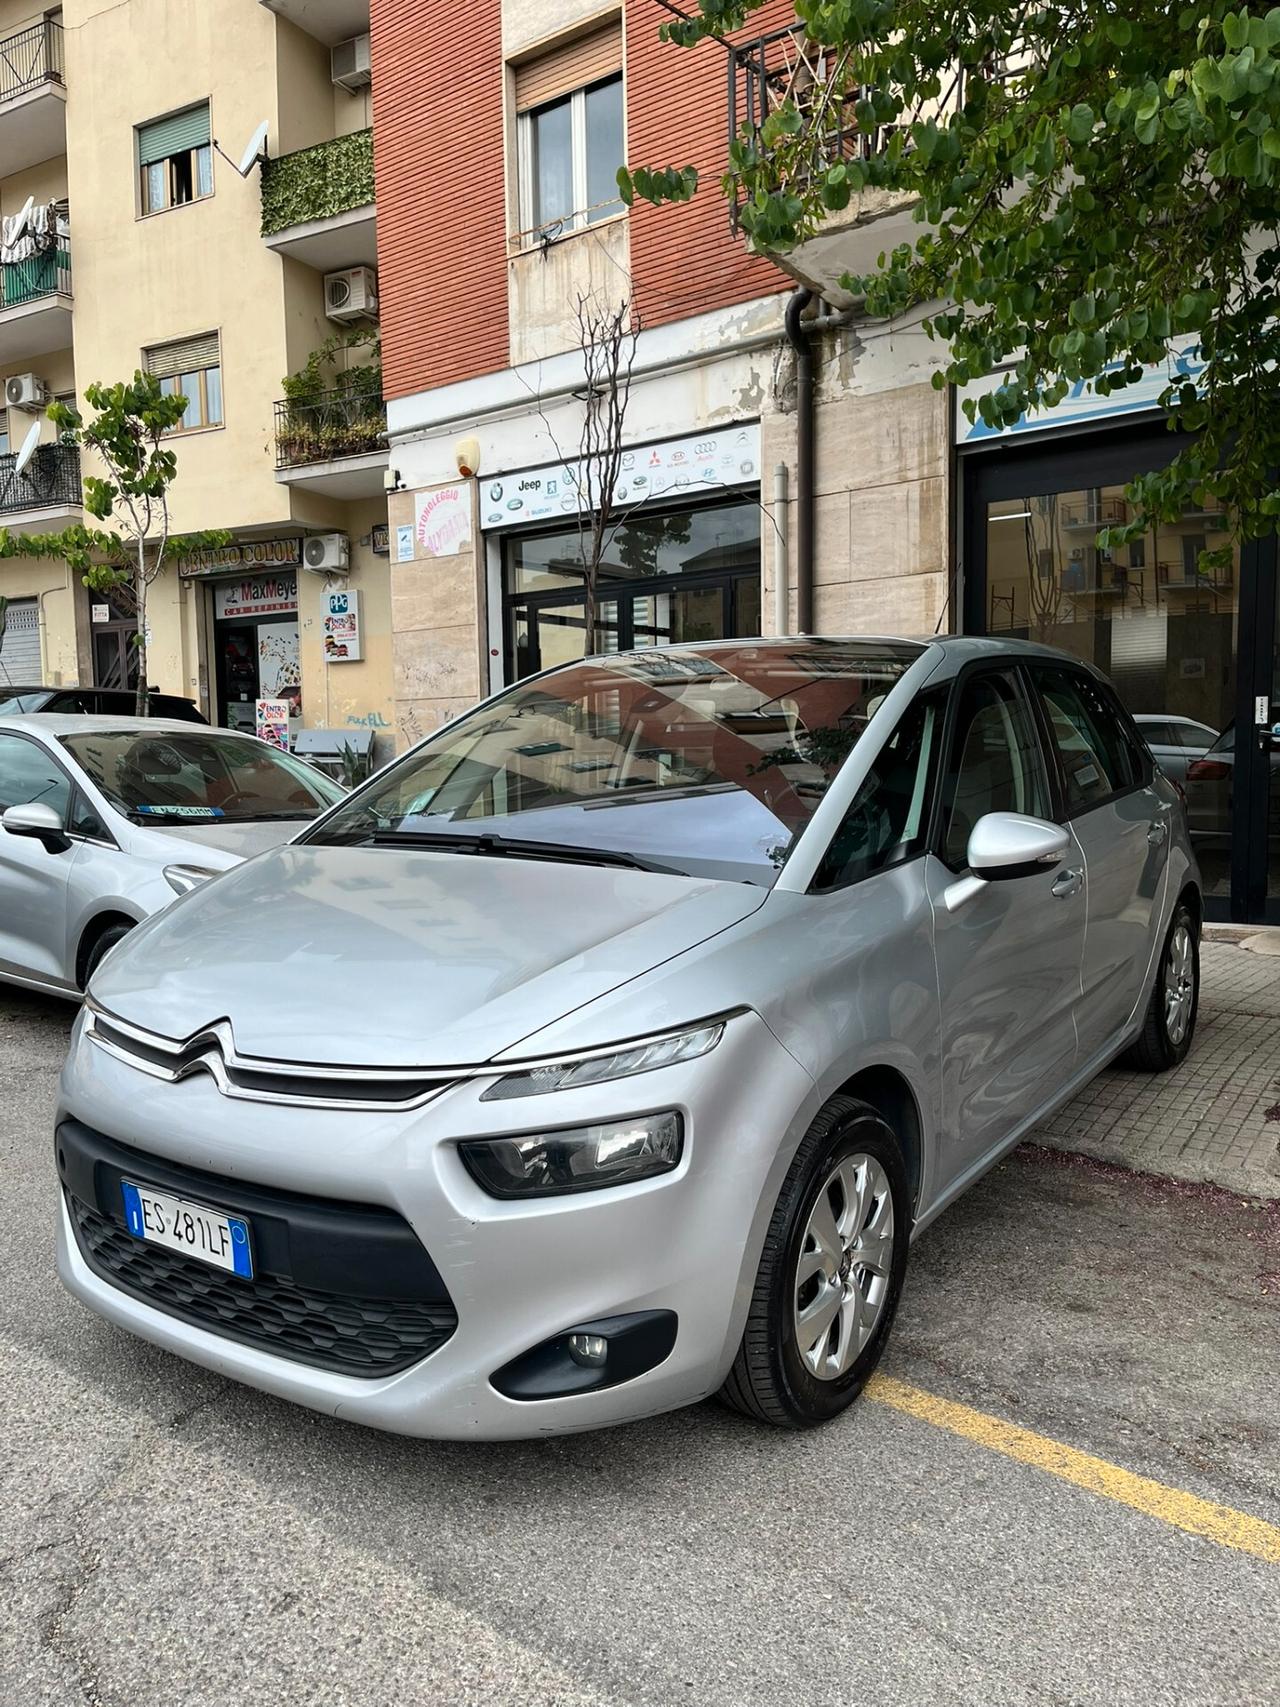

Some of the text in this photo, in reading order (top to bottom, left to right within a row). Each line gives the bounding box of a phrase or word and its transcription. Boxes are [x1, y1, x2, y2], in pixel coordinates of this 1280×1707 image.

[518, 480, 541, 491] Jeep
[242, 540, 299, 563] COLOR
[330, 594, 348, 610] PPG
[141, 1199, 165, 1234] ES
[173, 1209, 229, 1257] 481LF
